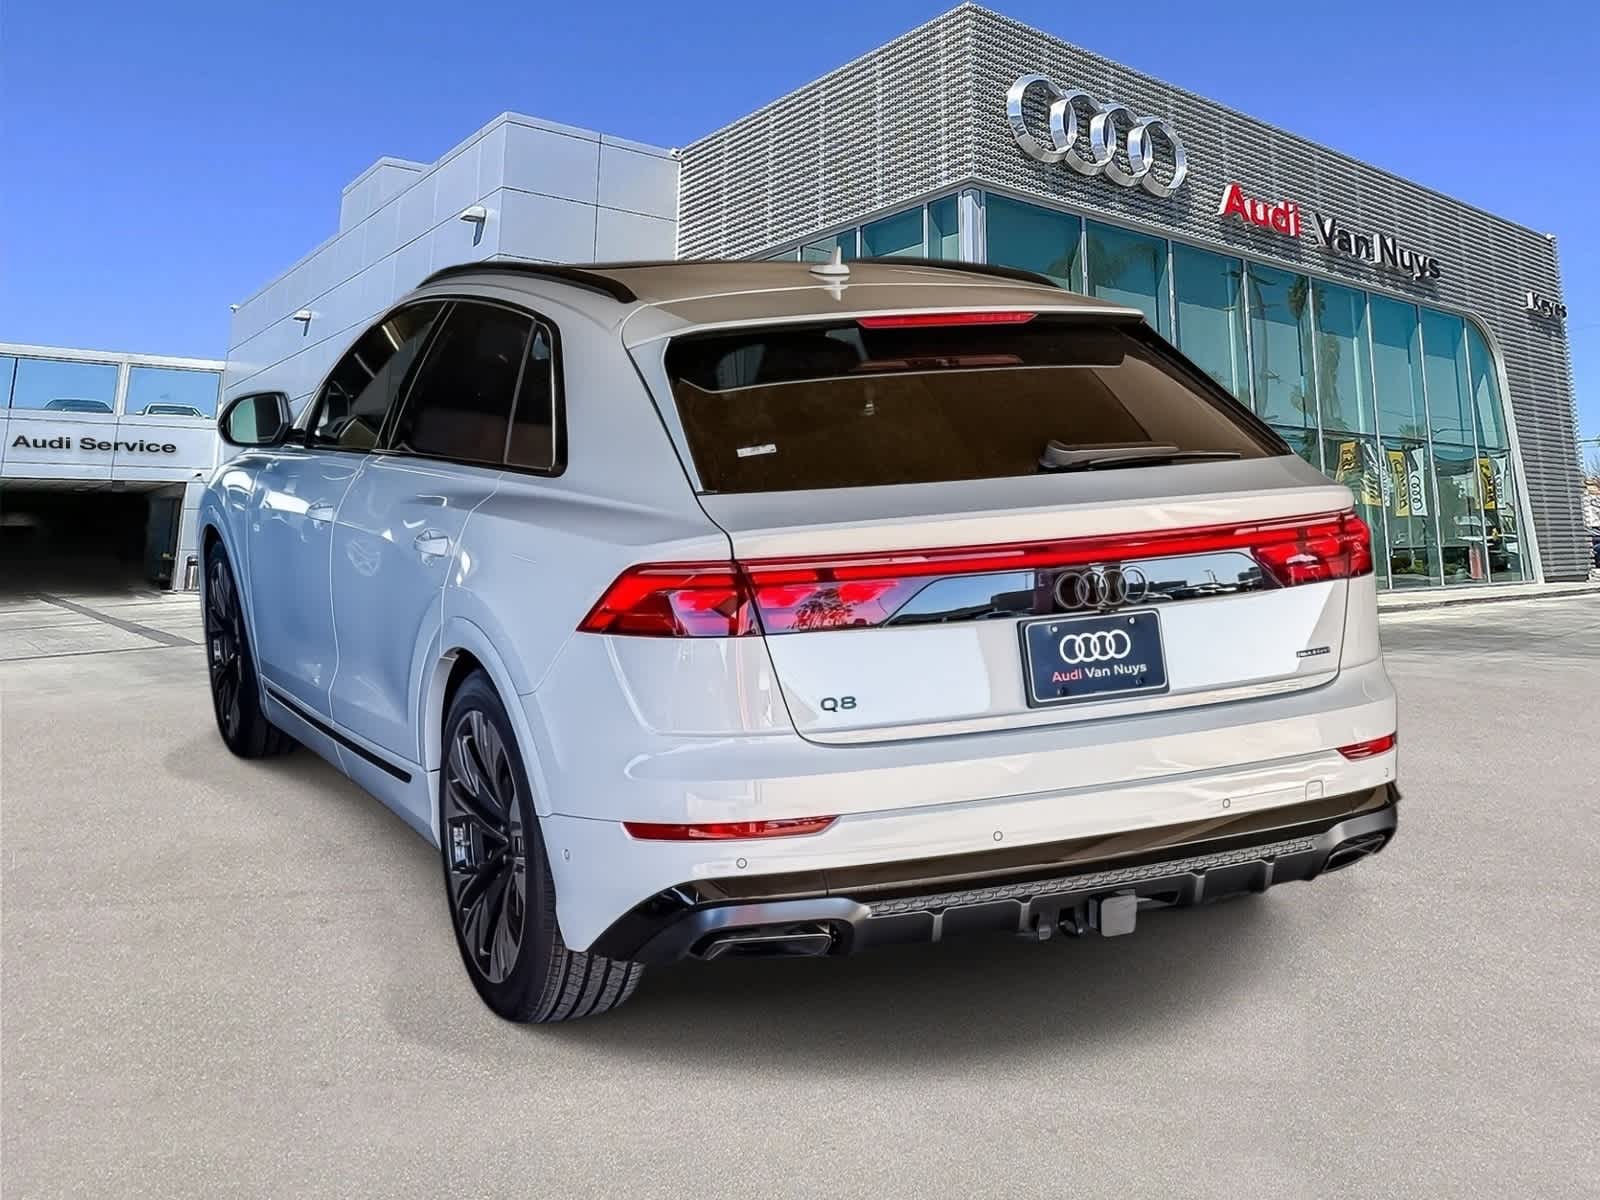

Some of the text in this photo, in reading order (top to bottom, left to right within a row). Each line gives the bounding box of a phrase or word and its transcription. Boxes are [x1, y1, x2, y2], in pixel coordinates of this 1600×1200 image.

[1219, 181, 1441, 280] Audi Van Nuys
[12, 435, 177, 453] Audi Service
[1052, 663, 1147, 683] Audi Van Nuys
[820, 696, 857, 712] Q8
